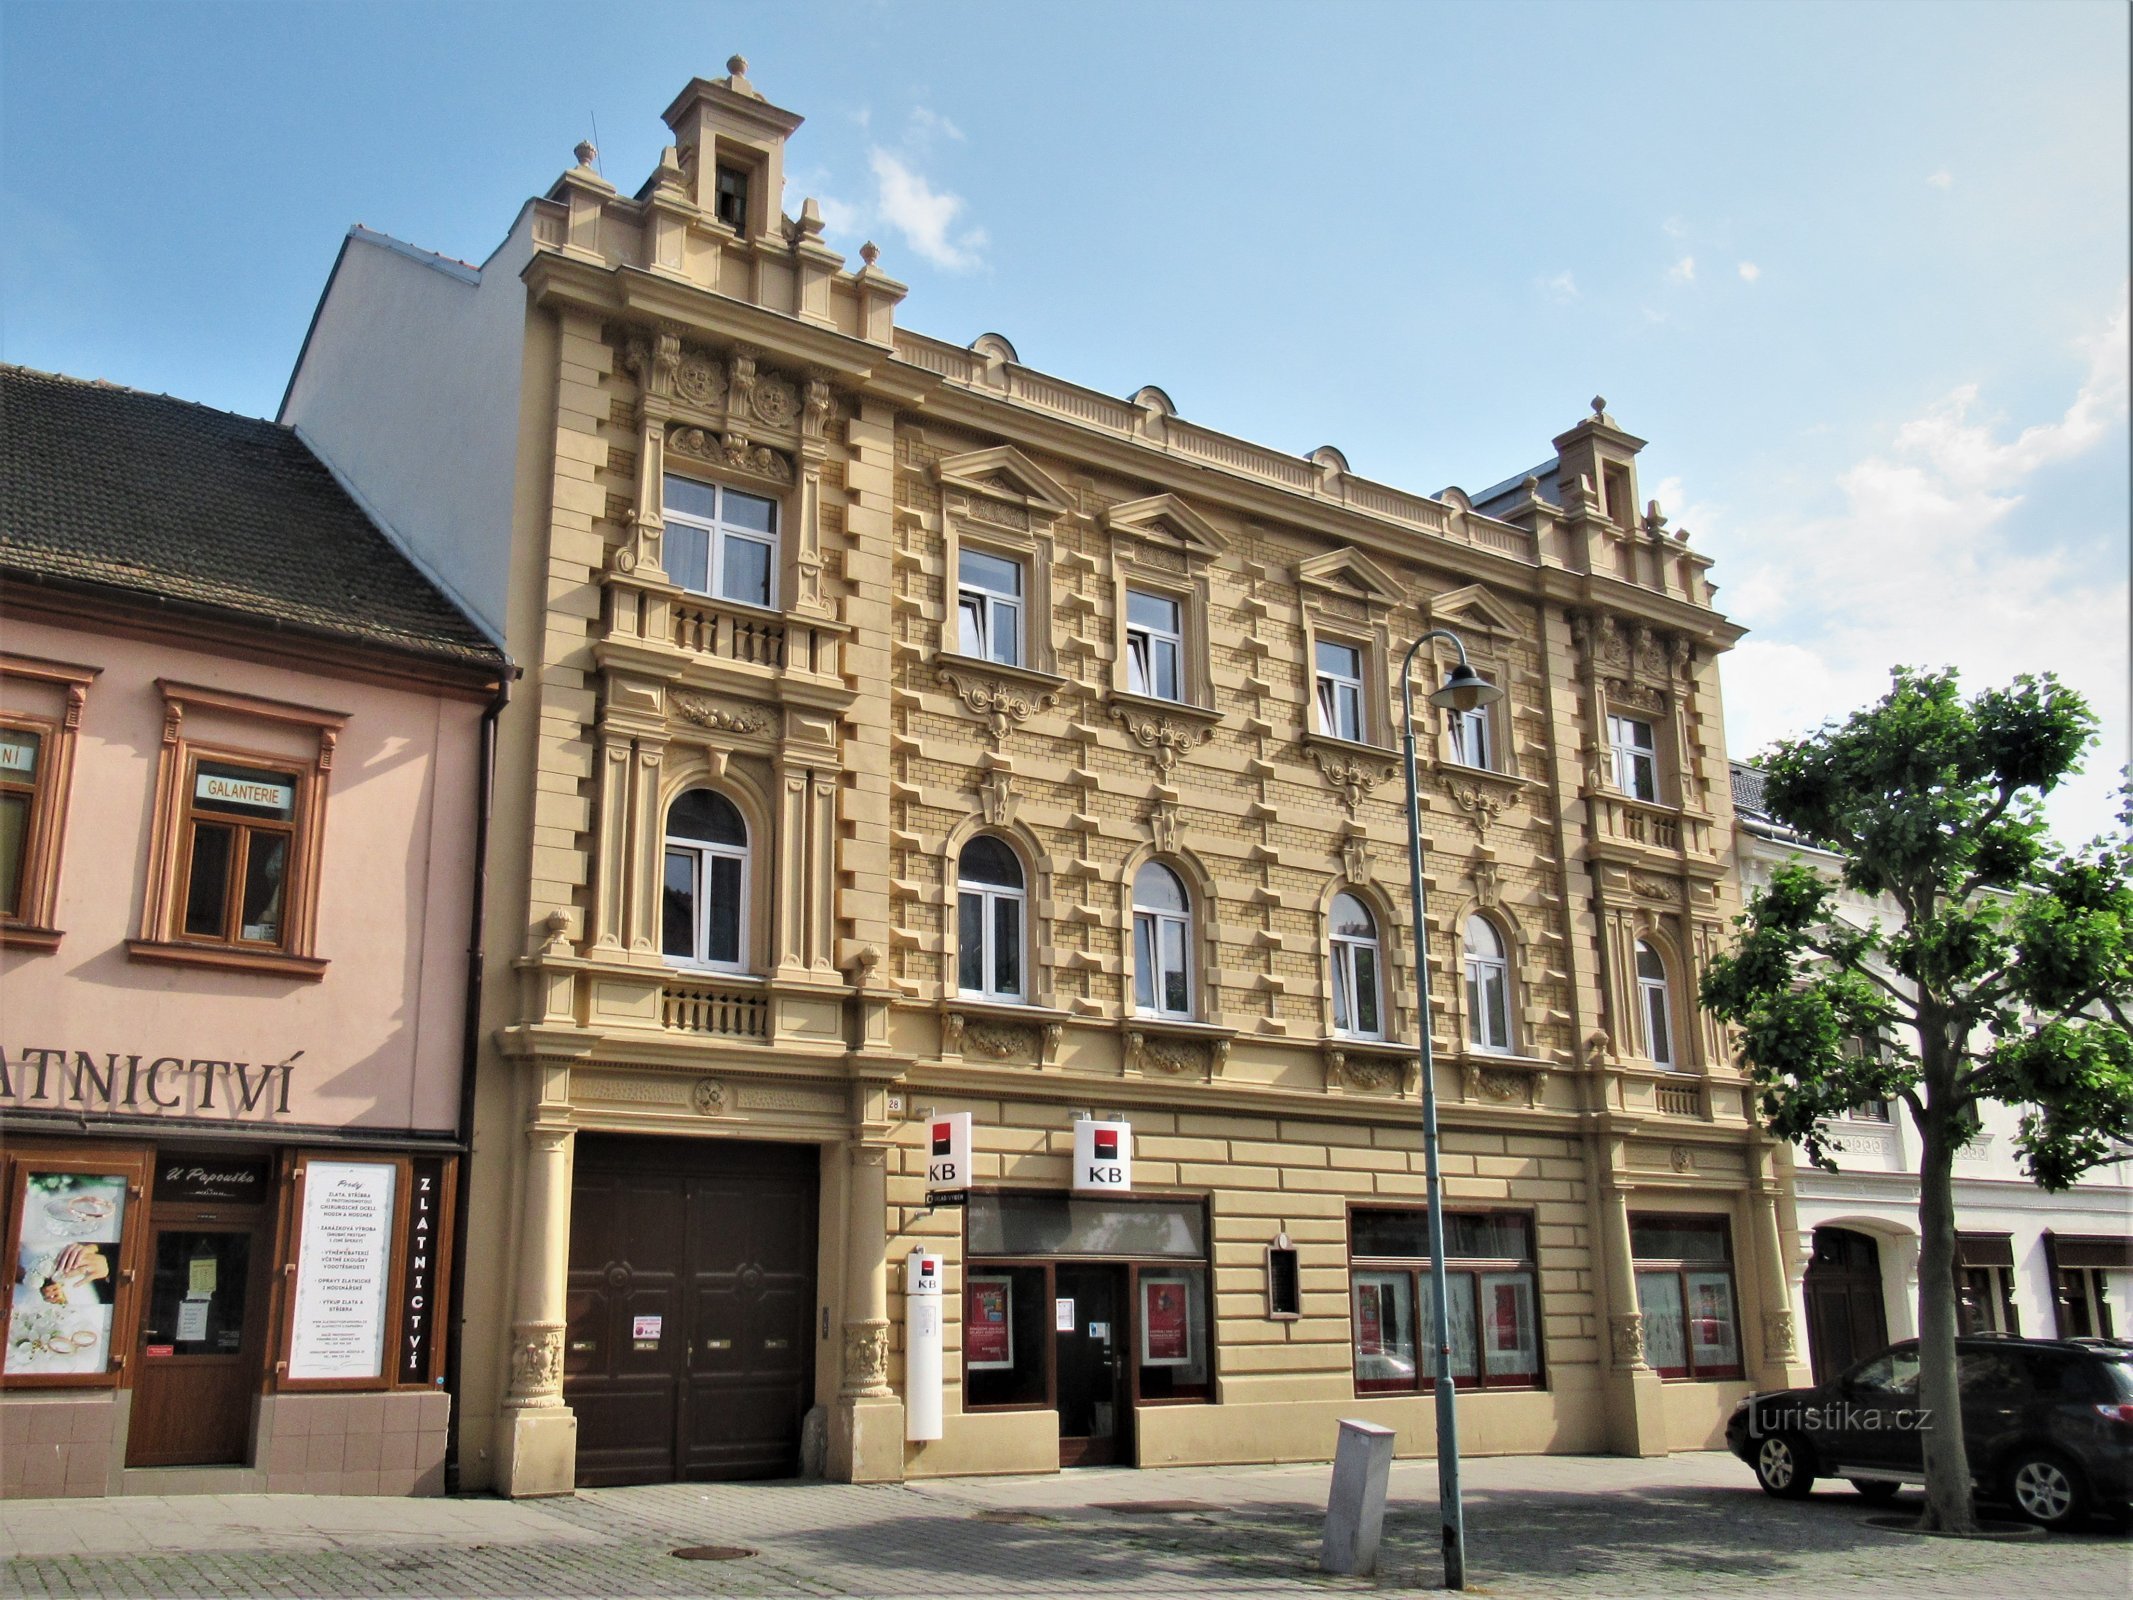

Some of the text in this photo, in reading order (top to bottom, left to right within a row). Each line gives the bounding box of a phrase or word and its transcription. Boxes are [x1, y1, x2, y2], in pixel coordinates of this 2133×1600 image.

[207, 779, 280, 804] GALANTERIE
[889, 1099, 899, 1109] 28
[186, 1167, 256, 1185] Papouška
[929, 1163, 956, 1182] KB
[1089, 1166, 1122, 1183] KB
[409, 1178, 431, 1369] ZLATNICTVÍ
[918, 1279, 936, 1289] KB
